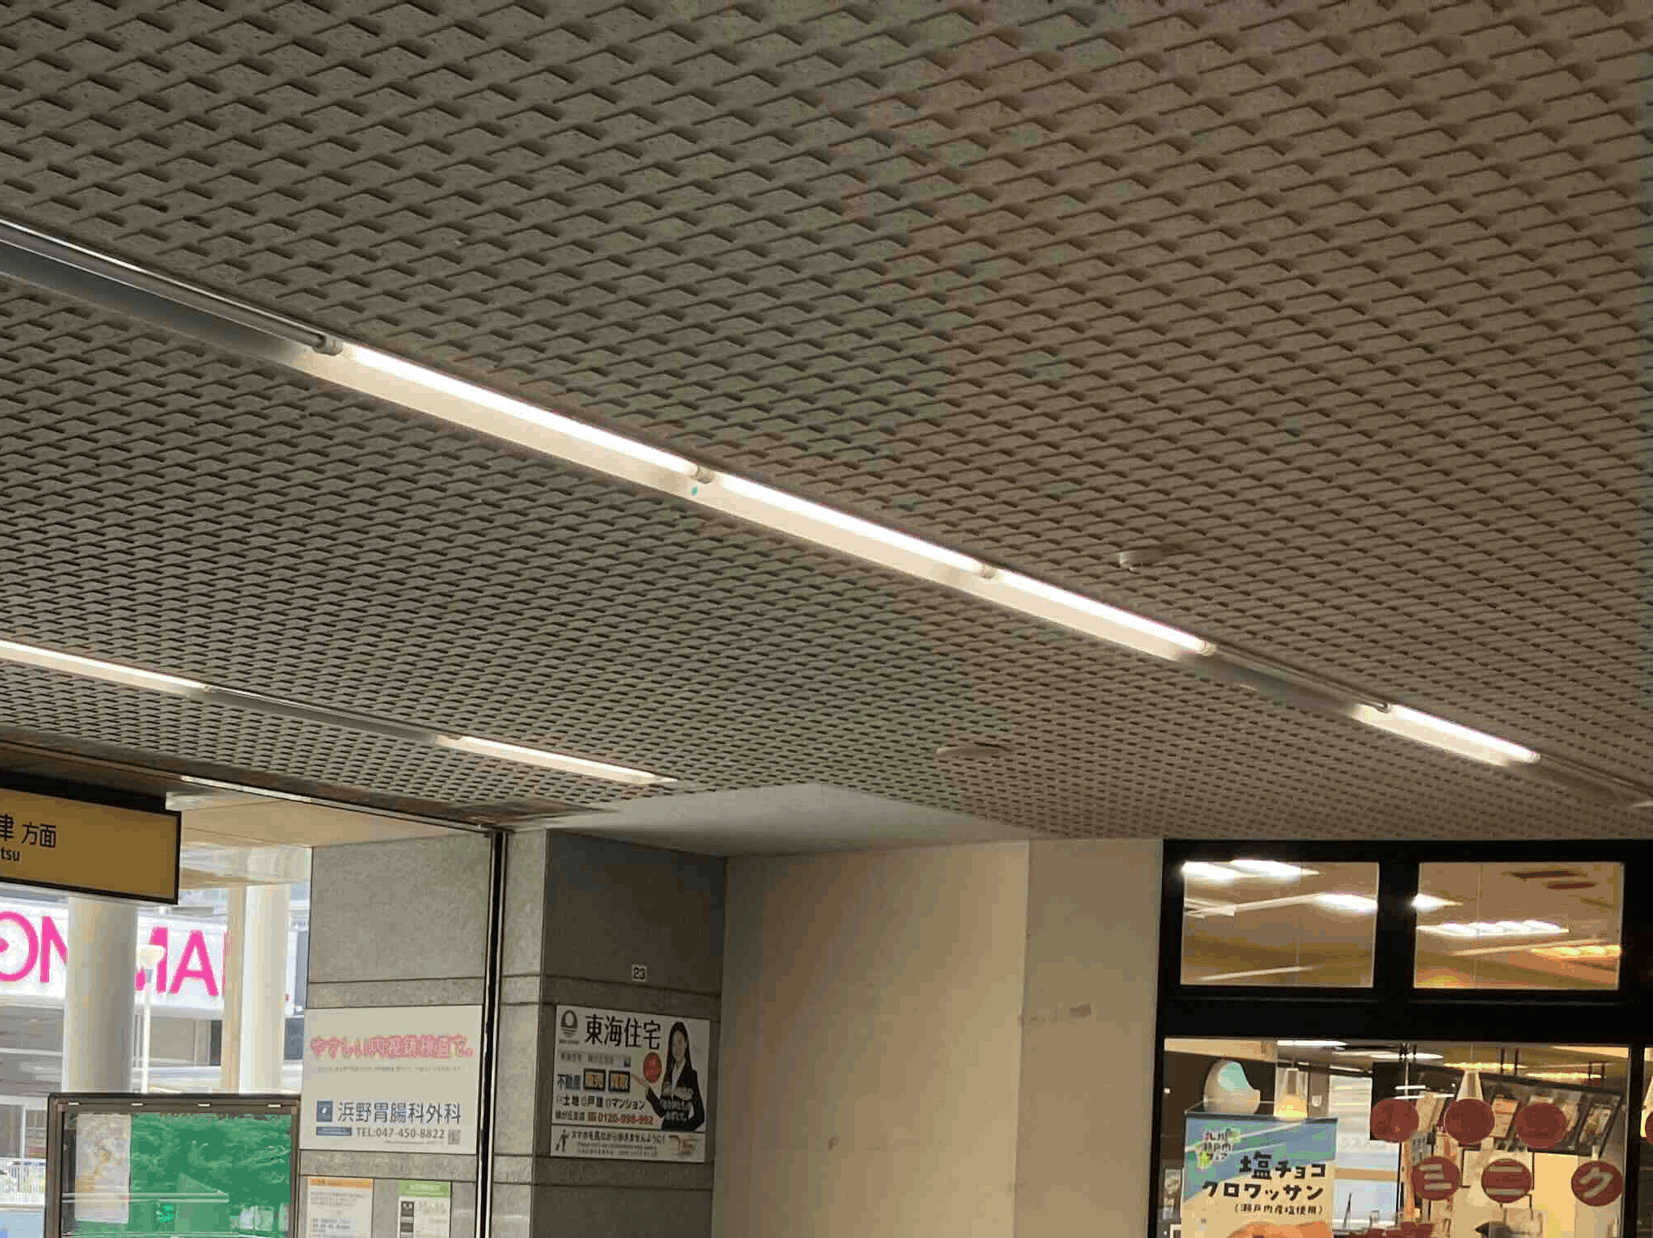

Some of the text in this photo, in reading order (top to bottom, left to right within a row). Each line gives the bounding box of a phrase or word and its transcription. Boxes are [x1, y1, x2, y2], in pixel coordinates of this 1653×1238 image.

[21, 821, 57, 848] 方面
[633, 966, 646, 981] 23
[584, 1014, 662, 1050] 東海住宅
[338, 1101, 462, 1125] 浜野胃腸科外科
[356, 1127, 445, 1140] TEL:047-450-8822
[1239, 1151, 1327, 1180] 塩チョコ
[1202, 1181, 1324, 1201] クロワッサン
